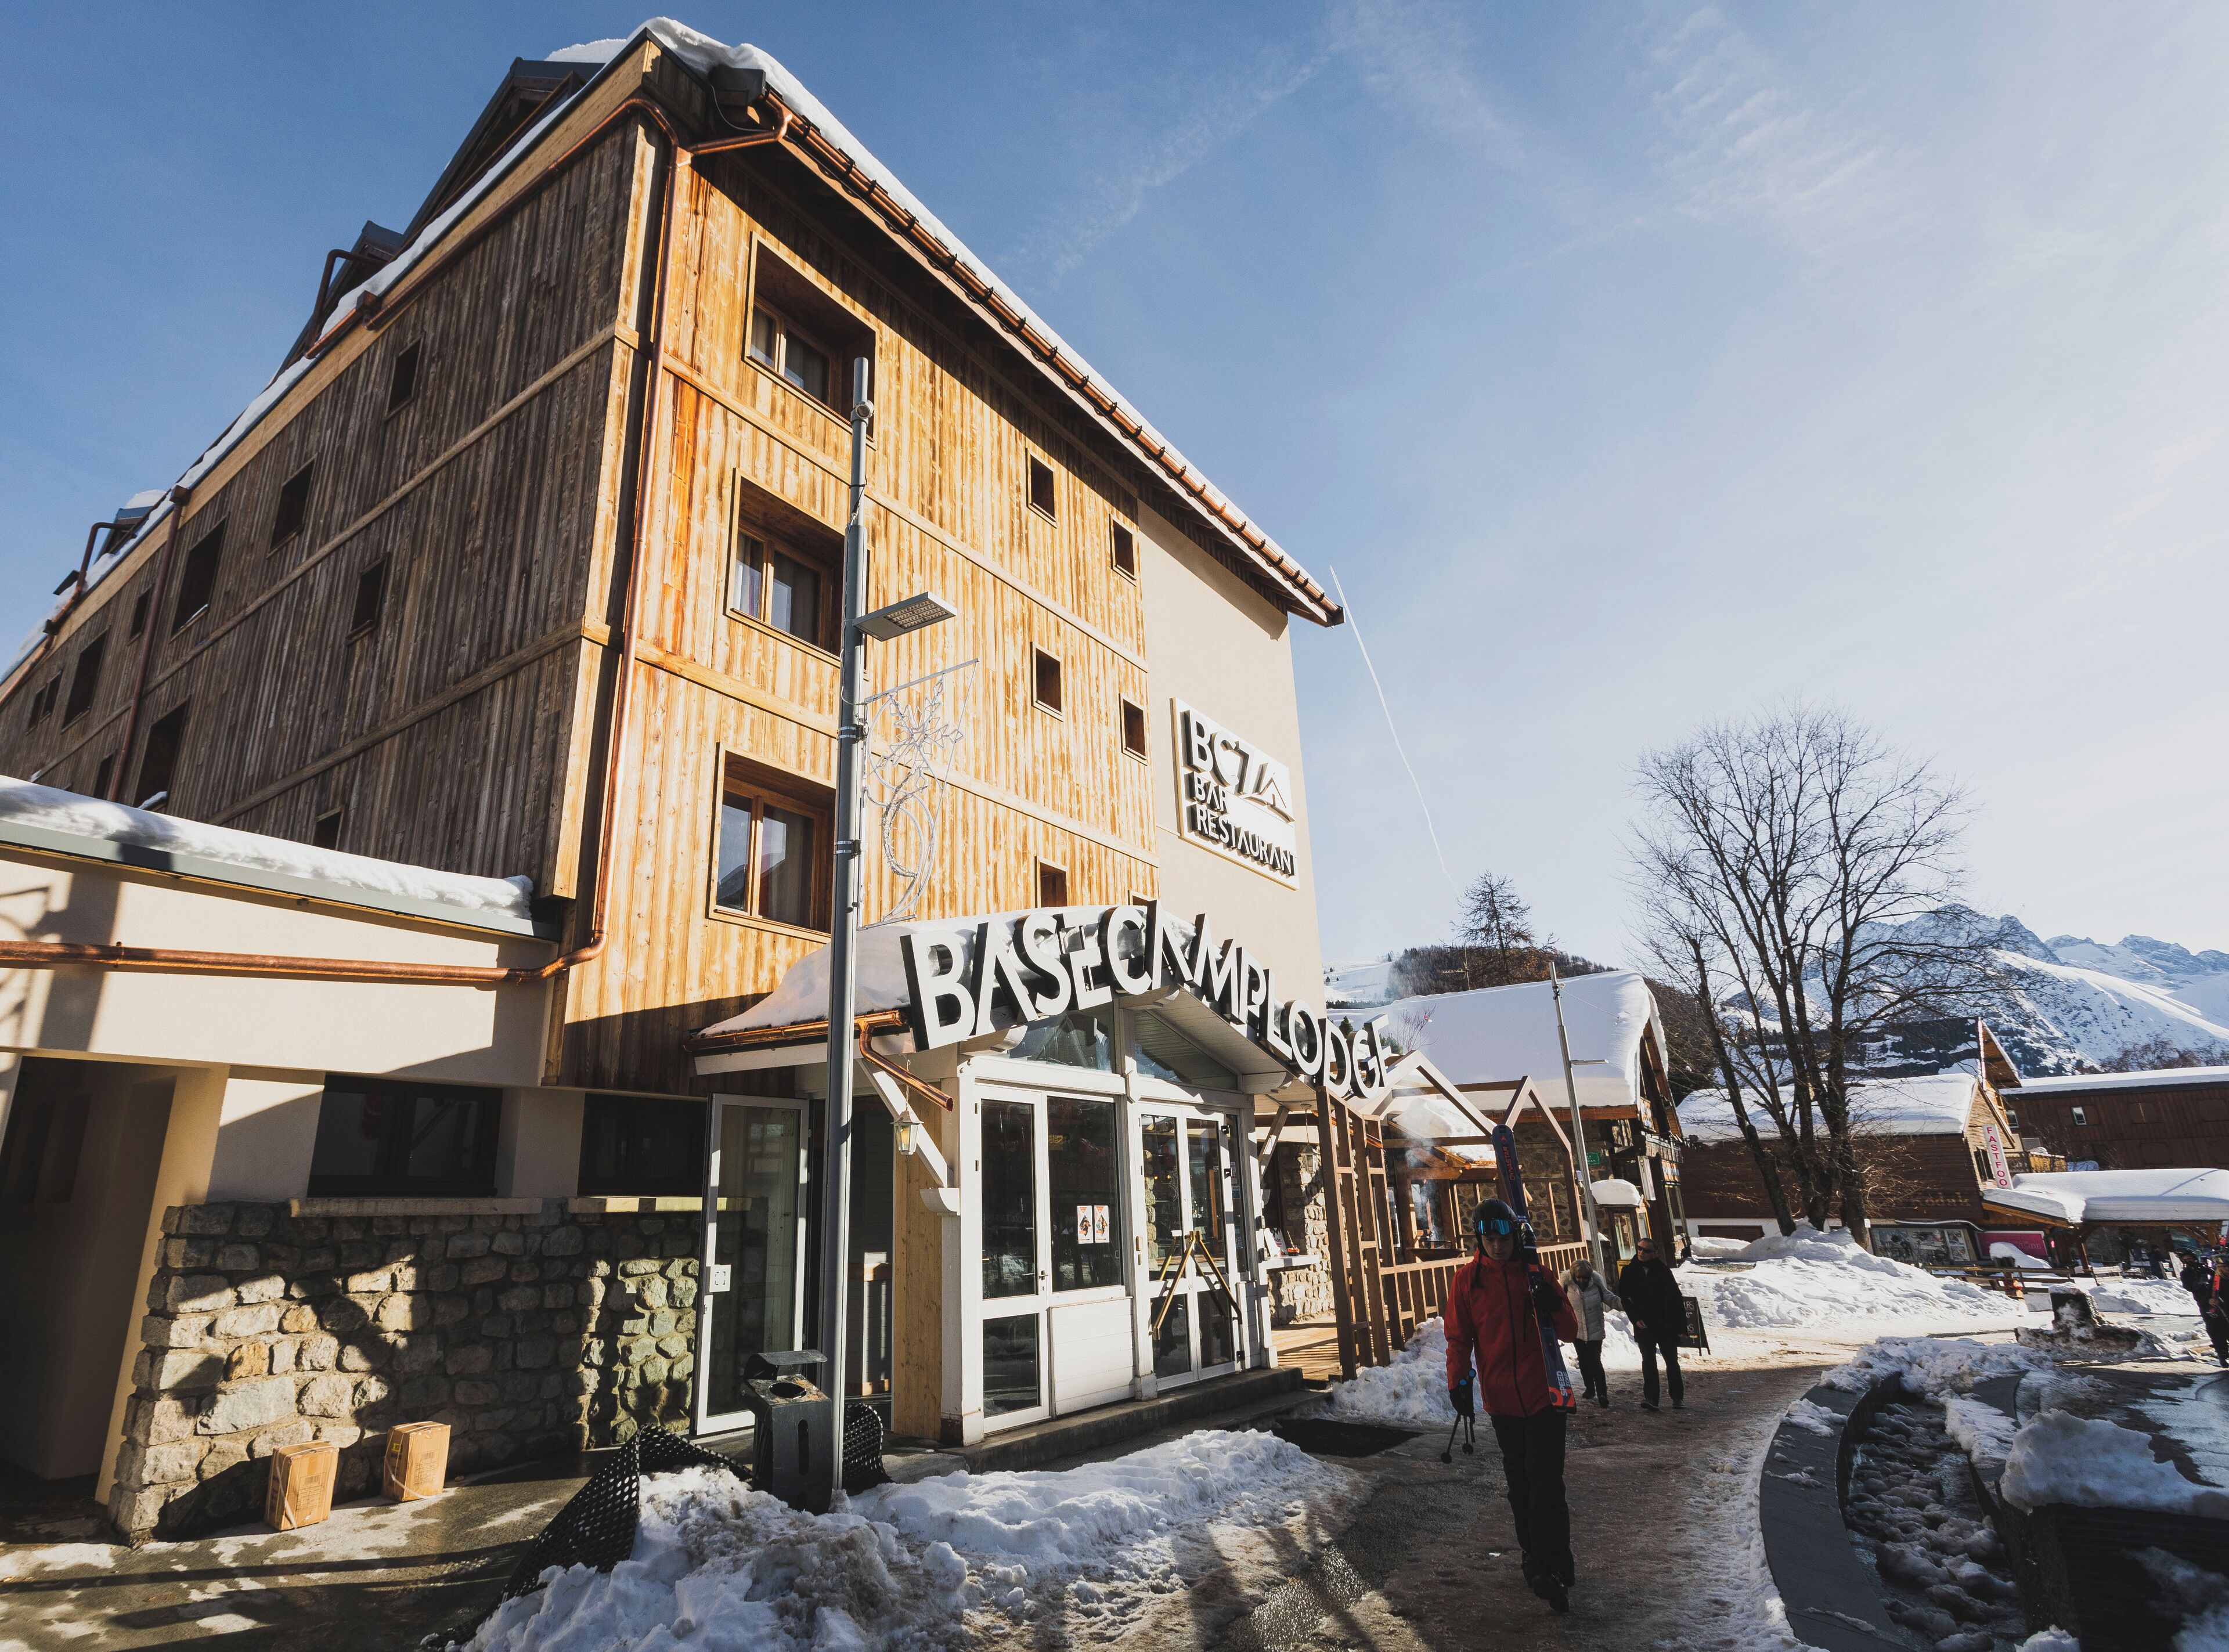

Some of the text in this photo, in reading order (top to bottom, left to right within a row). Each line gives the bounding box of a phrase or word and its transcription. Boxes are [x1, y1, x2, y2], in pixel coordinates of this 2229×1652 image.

[1185, 771, 1228, 814] BAR
[1186, 804, 1298, 878] RESTAURANT
[1502, 1146, 1516, 1181] DYNASTAR
[1986, 1127, 2008, 1186] FASTFOO
[1556, 1370, 1568, 1396] SPEED
